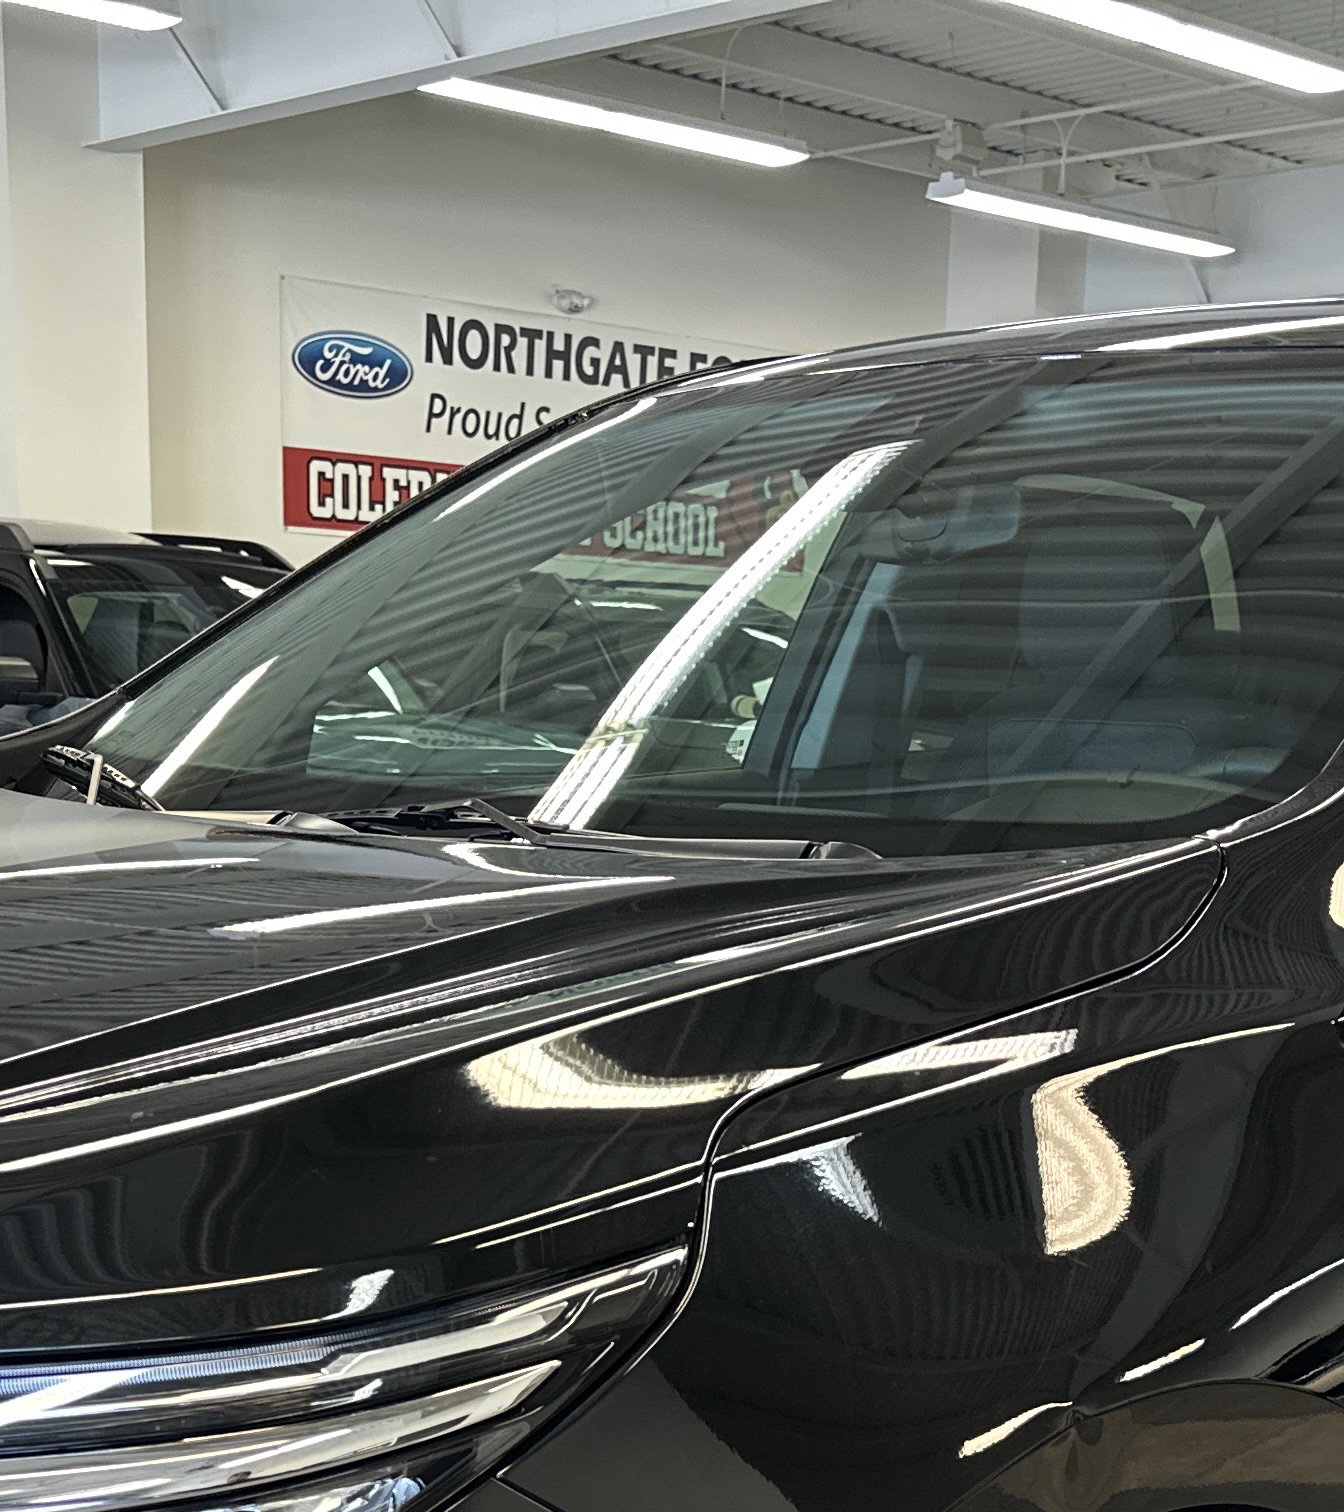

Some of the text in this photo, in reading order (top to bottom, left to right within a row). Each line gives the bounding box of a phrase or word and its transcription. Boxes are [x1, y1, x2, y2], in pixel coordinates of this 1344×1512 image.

[314, 339, 393, 389] Ford
[425, 392, 526, 442] Proud
[308, 457, 452, 524] COLE
